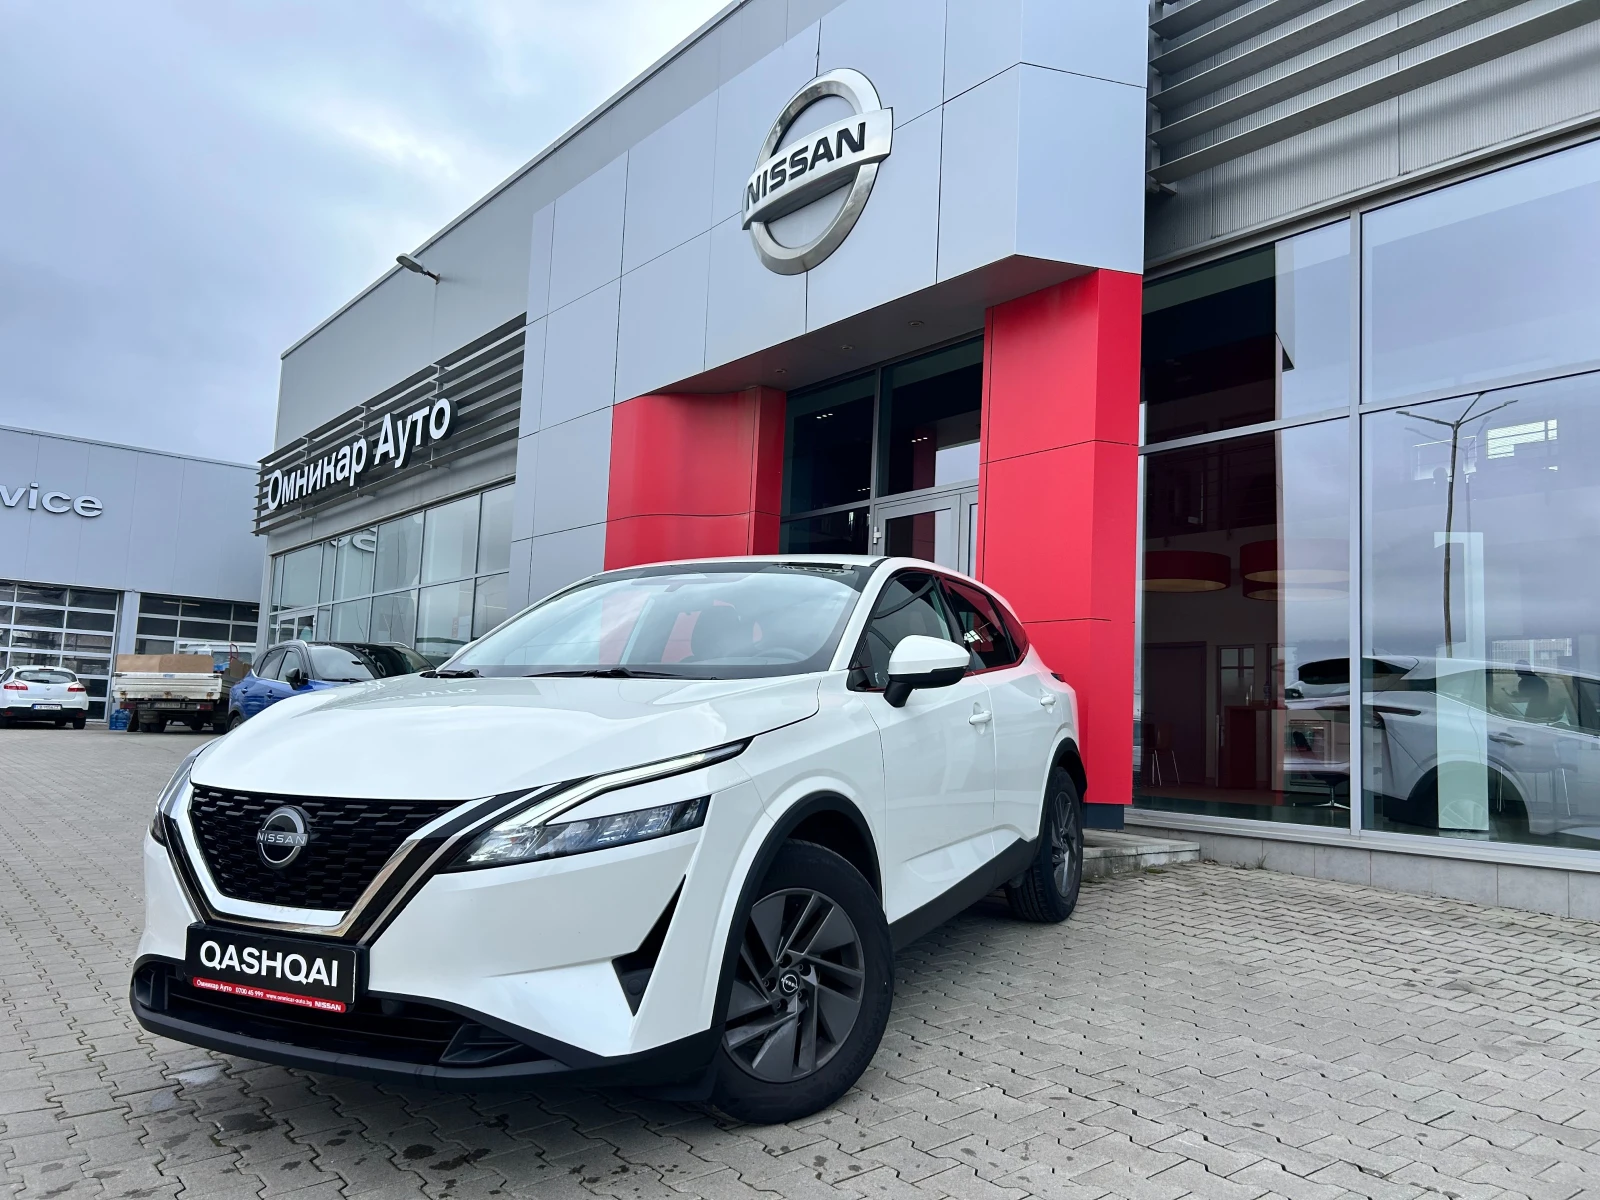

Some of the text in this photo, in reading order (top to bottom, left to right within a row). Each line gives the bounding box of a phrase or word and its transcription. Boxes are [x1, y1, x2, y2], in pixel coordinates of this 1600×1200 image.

[745, 121, 867, 211] NISSAN
[267, 398, 455, 511] Омникар Ауто
[0, 482, 103, 518] vice
[256, 832, 306, 845] NISSAN
[199, 940, 339, 987] QASHQAI
[220, 983, 233, 993] Ауто
[235, 986, 247, 995] 0700
[248, 989, 254, 997] 45
[254, 990, 264, 998] 999
[314, 1000, 342, 1011] NISSAN
